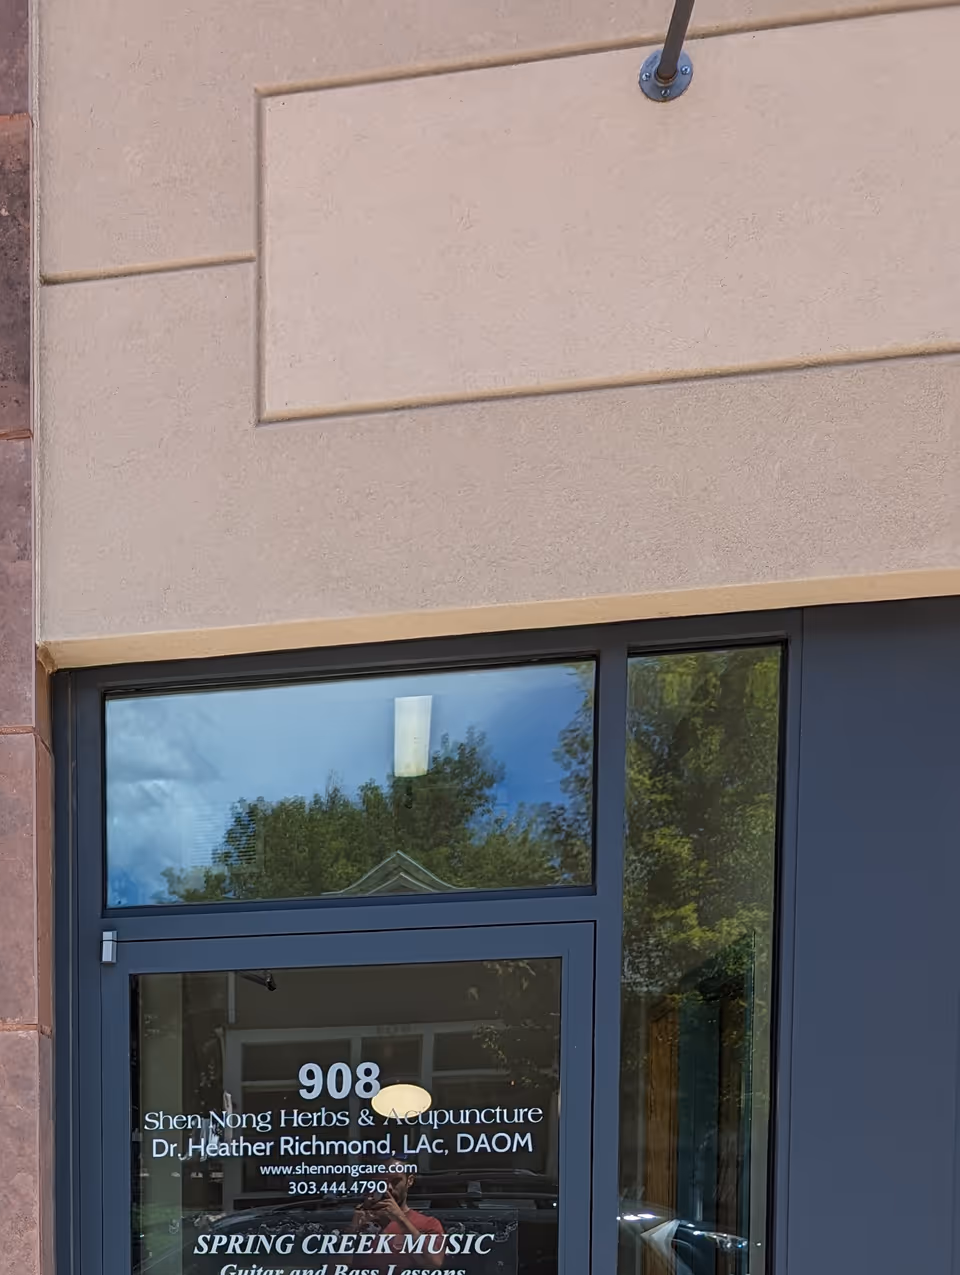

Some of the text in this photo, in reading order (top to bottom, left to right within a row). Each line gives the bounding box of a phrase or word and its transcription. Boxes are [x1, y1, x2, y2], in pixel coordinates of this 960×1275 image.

[298, 1061, 381, 1100] 908
[144, 1105, 544, 1132] Shen Nong Herbs & Acupuncture
[152, 1132, 534, 1158] Dr. Heather Richmond, LAc, DAOM
[259, 1162, 418, 1177] www.shennongcare.com
[288, 1180, 388, 1195] 303.444.4790
[193, 1233, 495, 1255] SPRING CREEK MUSIC
